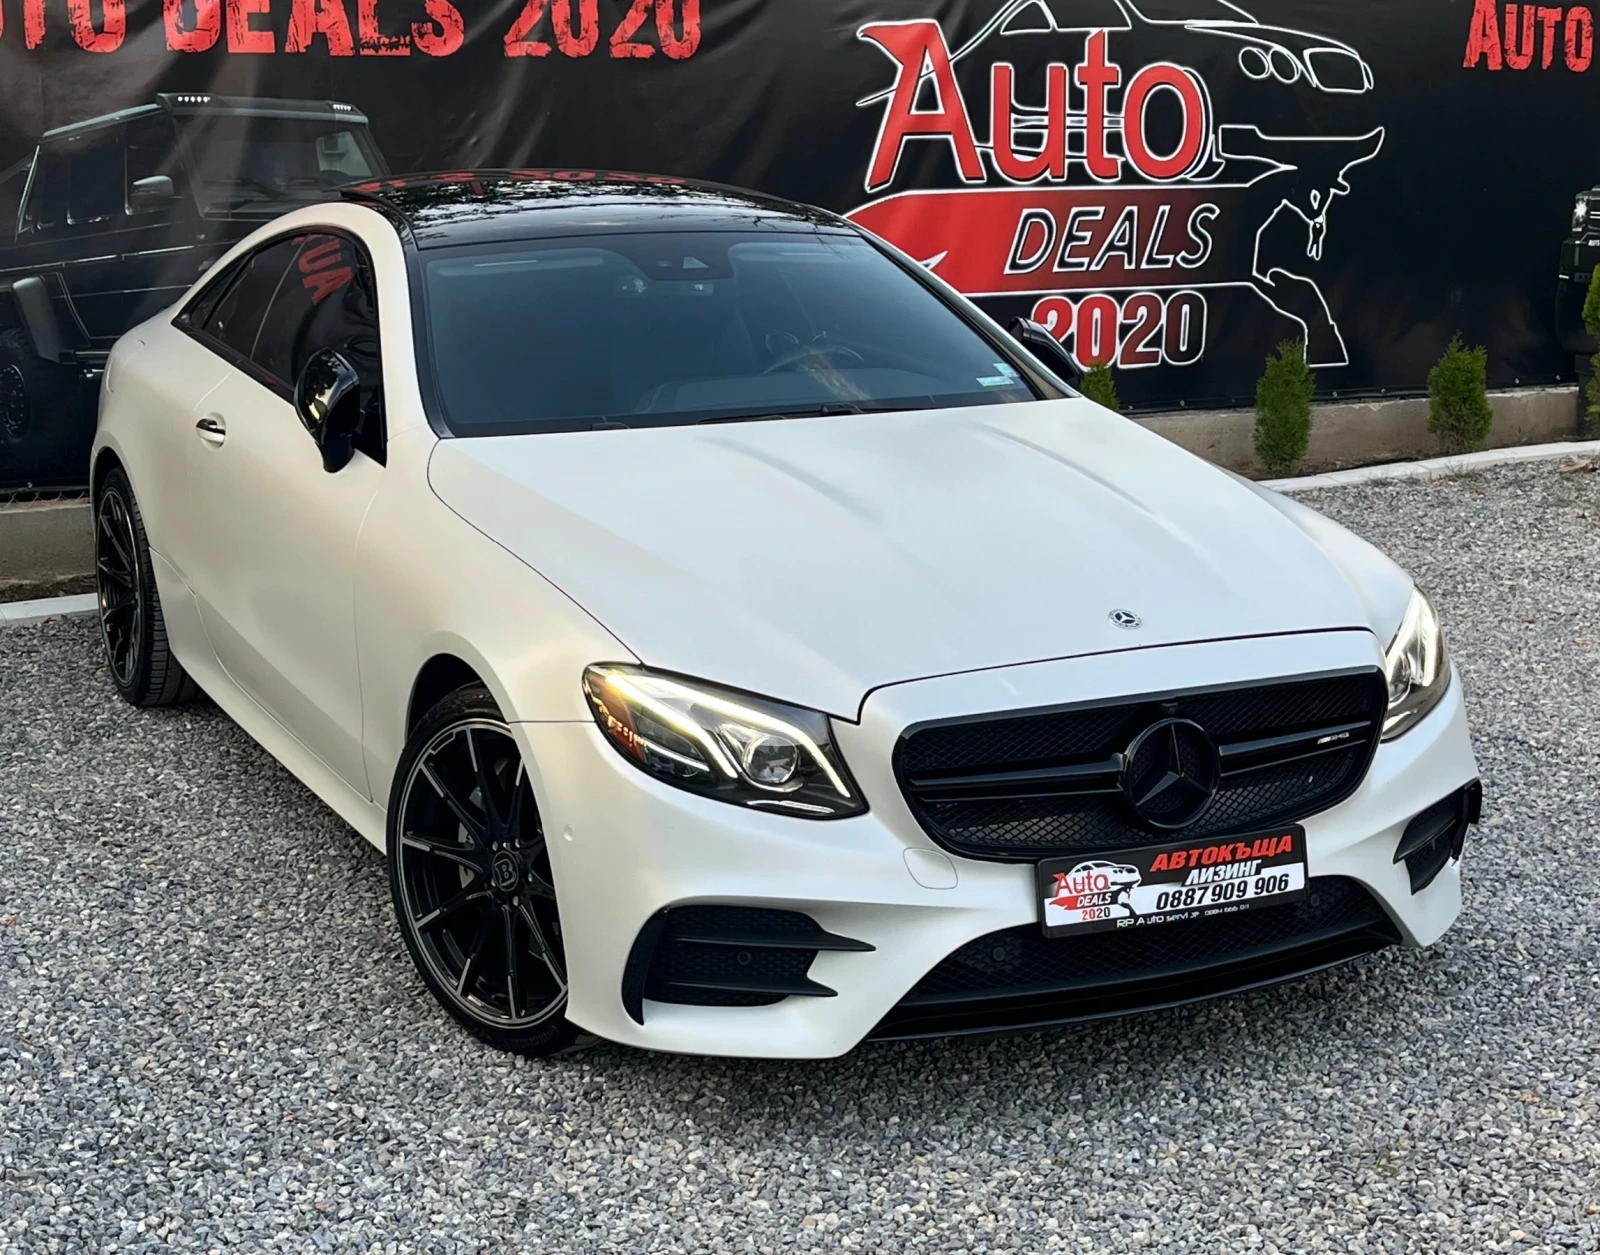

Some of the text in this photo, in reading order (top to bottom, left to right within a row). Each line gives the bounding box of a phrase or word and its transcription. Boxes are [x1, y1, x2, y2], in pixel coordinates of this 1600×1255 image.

[162, 0, 465, 57] DEALS
[503, 0, 701, 58] 2020
[1462, 0, 1594, 72] AUTO
[857, 20, 1208, 192] Auto
[1003, 203, 1221, 275] DEALS
[1031, 290, 1208, 372] 2020
[1150, 835, 1293, 872] АВТОКЪЩА
[1052, 870, 1110, 898] Auto
[1184, 859, 1262, 887] ЛИЗИНГ
[1076, 893, 1112, 908] DEALS
[1156, 873, 1290, 911] 0887 909 906
[1081, 907, 1111, 921] 2020
[1116, 918, 1134, 928] RP
